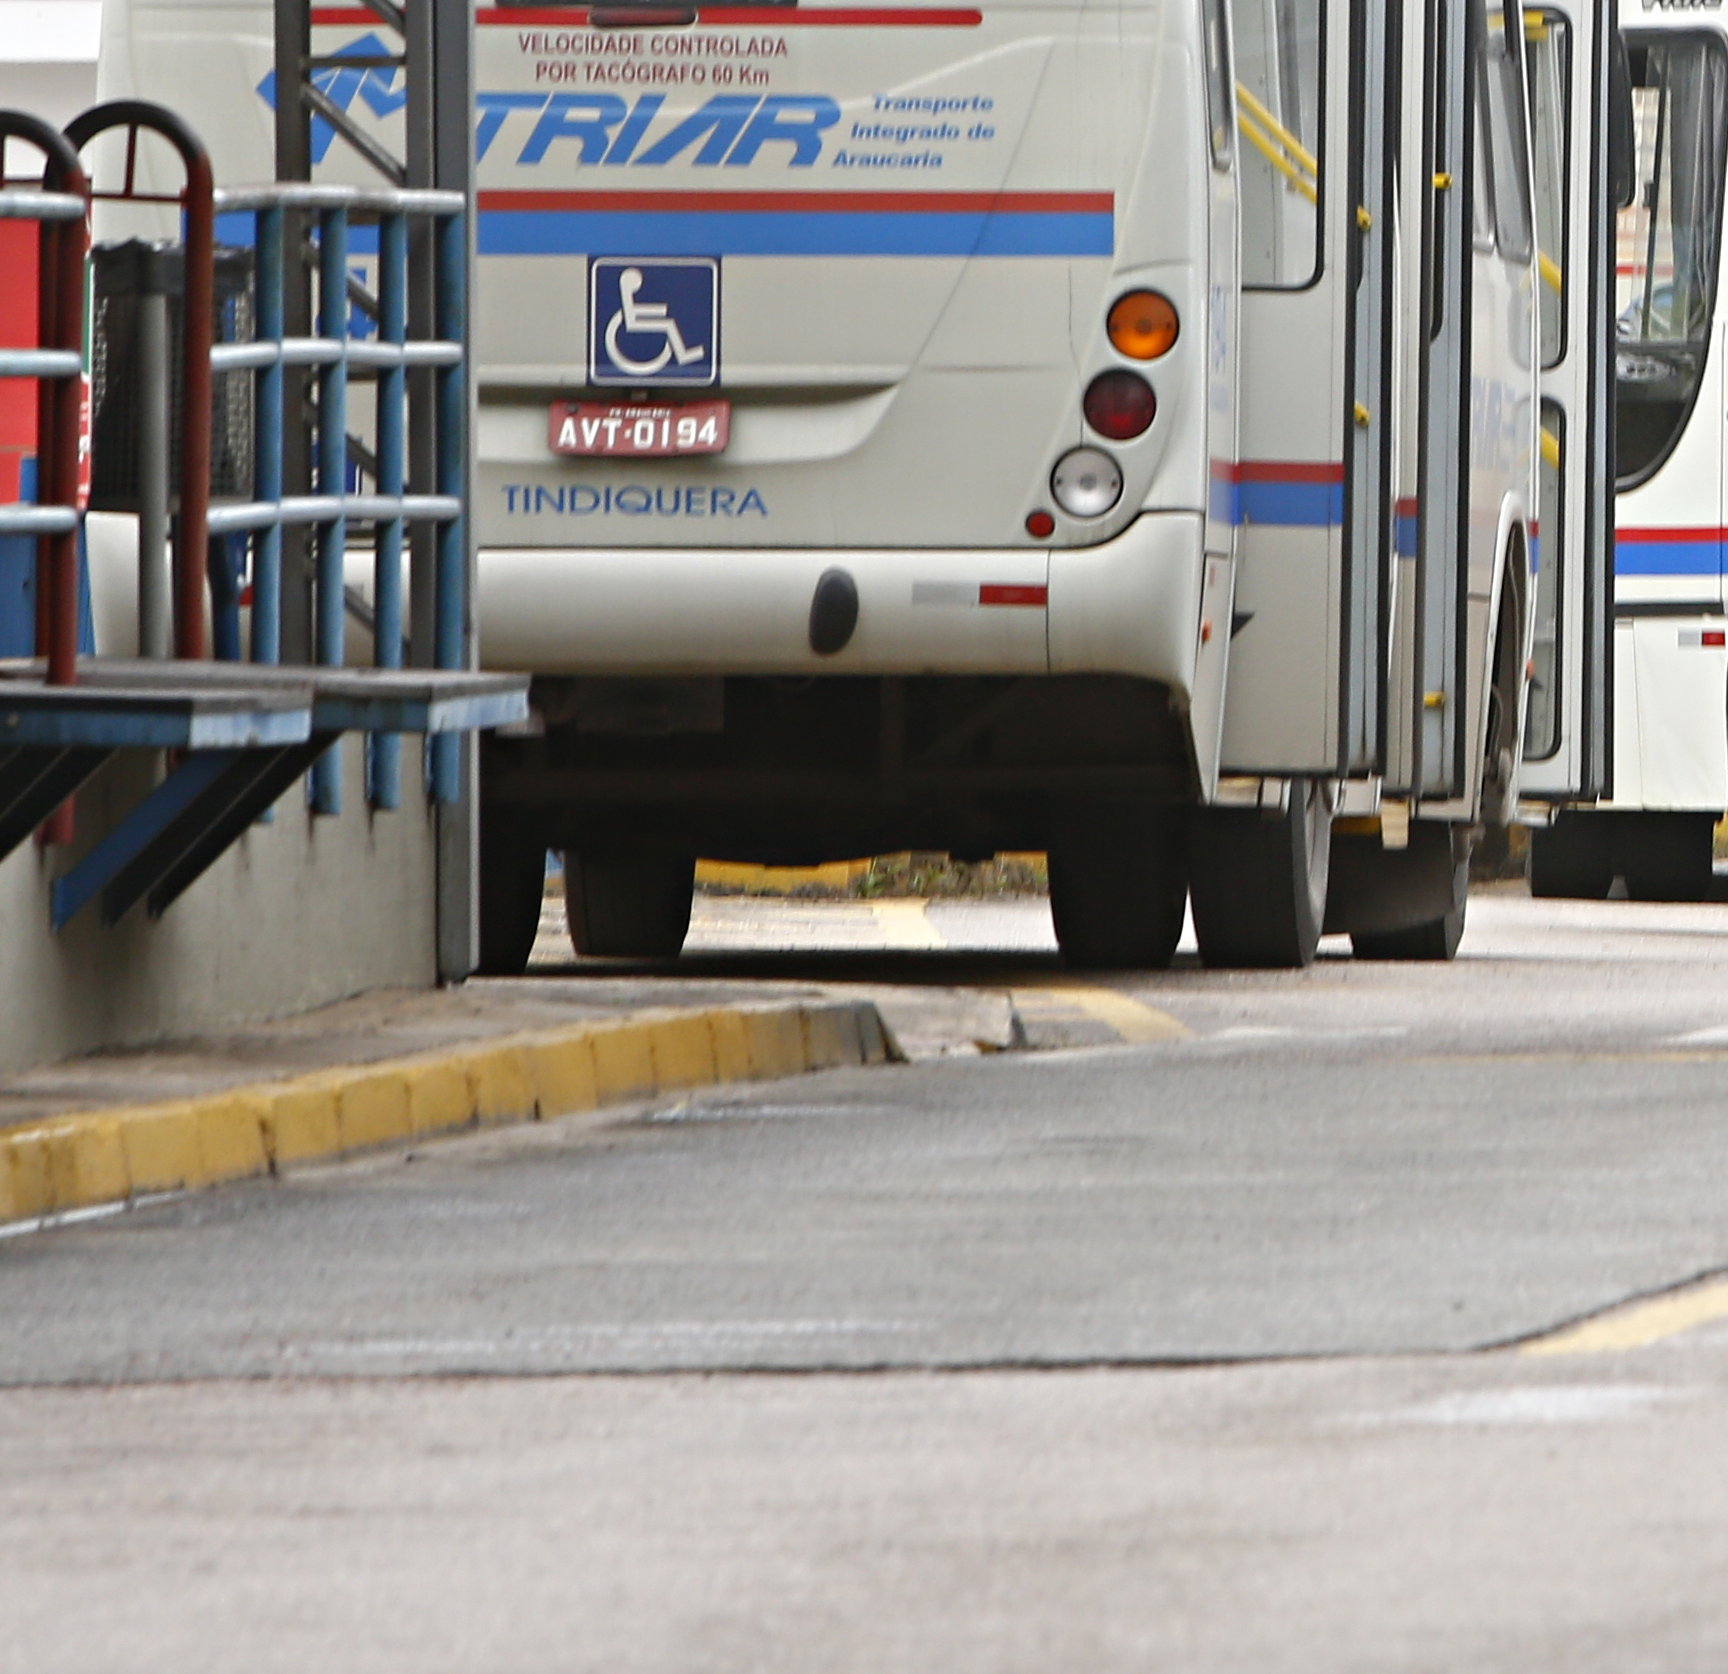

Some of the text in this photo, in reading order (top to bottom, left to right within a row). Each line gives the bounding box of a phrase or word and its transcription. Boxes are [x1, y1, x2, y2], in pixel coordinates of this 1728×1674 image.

[518, 33, 788, 59] VELOCIDADE CONTROLADA
[535, 58, 770, 87] POR TACÓGRAFO 60 Km
[873, 93, 994, 115] Transporte
[476, 91, 842, 169] TRIAR
[850, 122, 995, 145] Integrado de
[501, 483, 768, 517] TINDIQUERA
